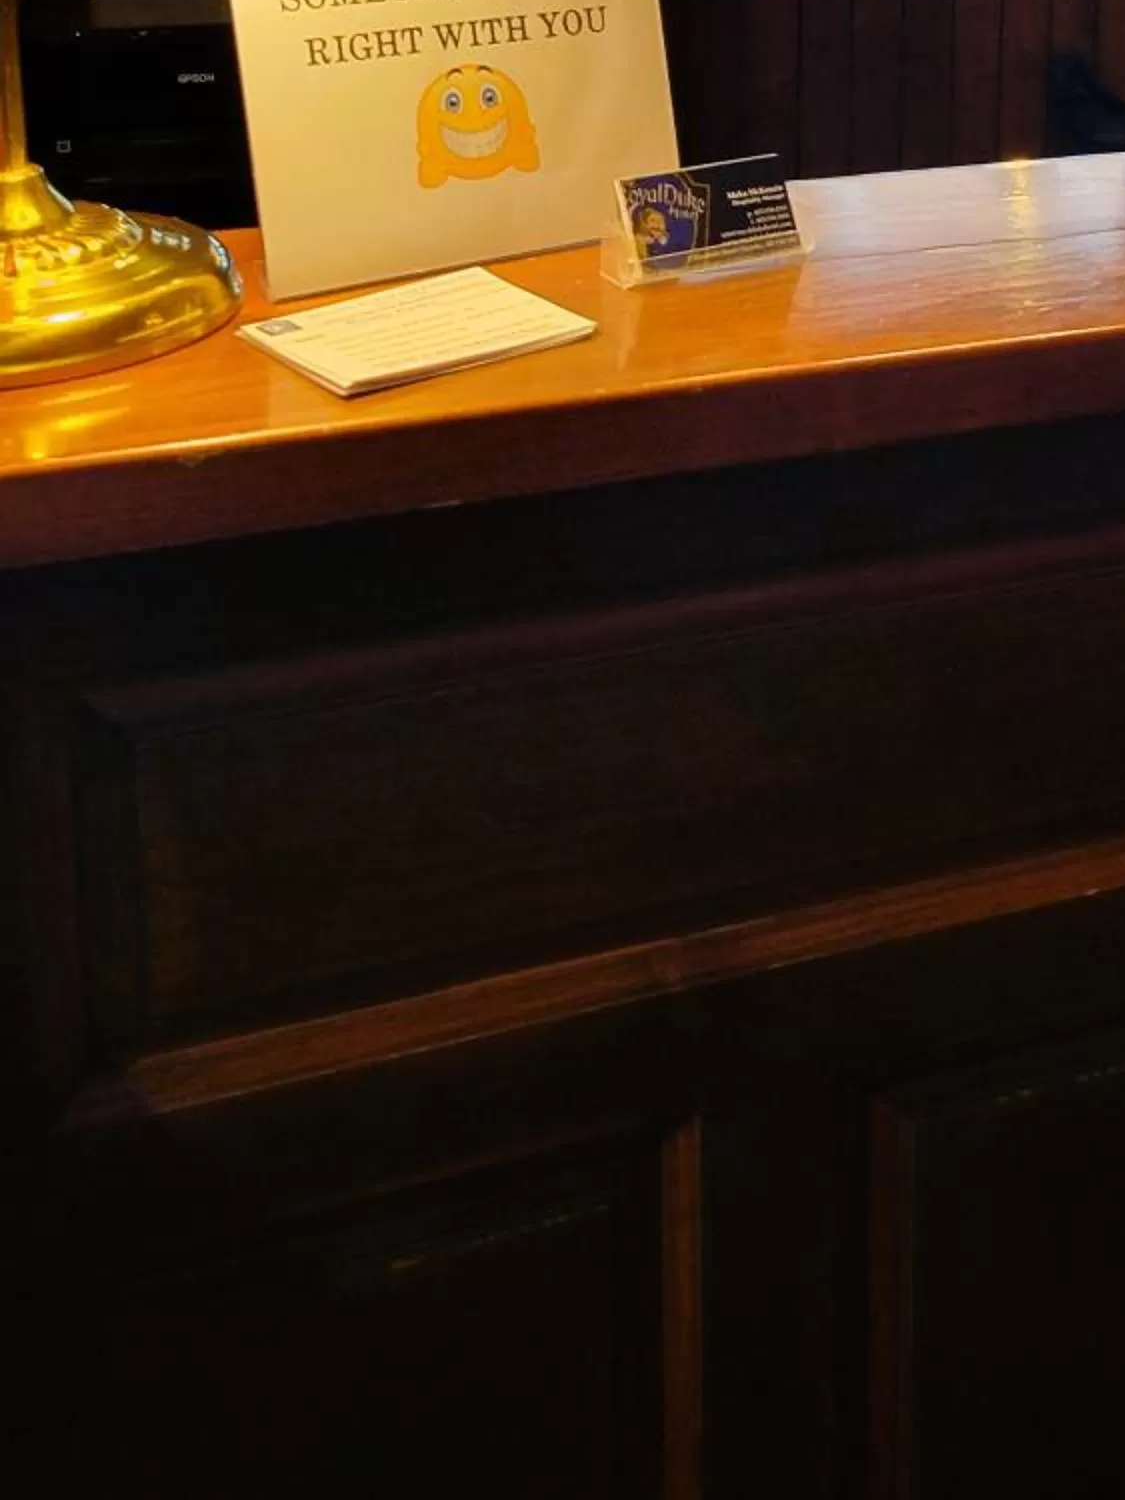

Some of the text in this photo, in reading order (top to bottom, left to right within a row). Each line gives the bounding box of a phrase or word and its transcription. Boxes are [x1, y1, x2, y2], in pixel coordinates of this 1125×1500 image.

[304, 6, 608, 67] RIGHT WITH YOU
